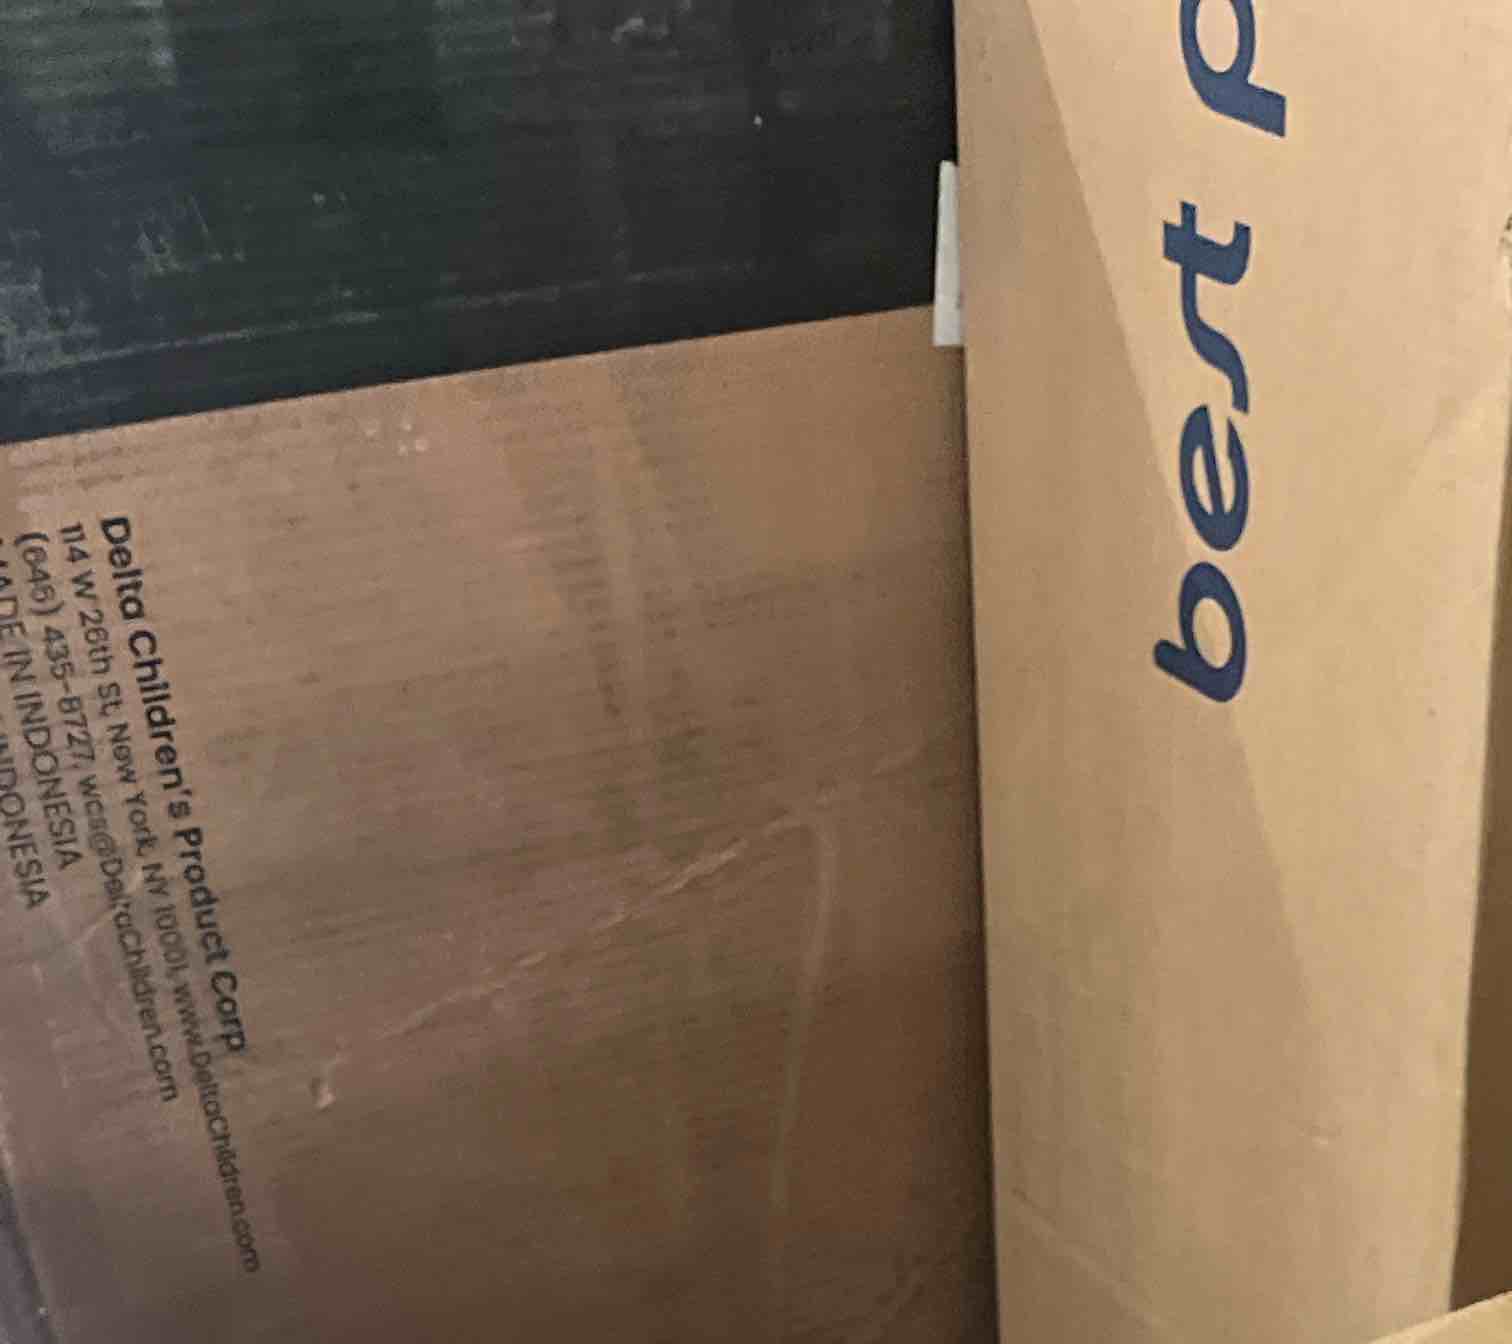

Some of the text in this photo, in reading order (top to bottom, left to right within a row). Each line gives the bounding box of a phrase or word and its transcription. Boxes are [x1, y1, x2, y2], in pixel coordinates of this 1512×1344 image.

[1153, 201, 1252, 703] best
[14, 531, 65, 617] (646)
[58, 522, 90, 563] 114
[71, 570, 98, 600] W
[2, 646, 37, 682] IN
[79, 609, 110, 675] 26th
[13, 690, 84, 870] INDONESIA
[100, 515, 247, 1055] Delta Children's Product Corp
[107, 722, 137, 785] New
[142, 861, 170, 898] NY
[171, 981, 260, 1274] www.DeltaChildren.com
